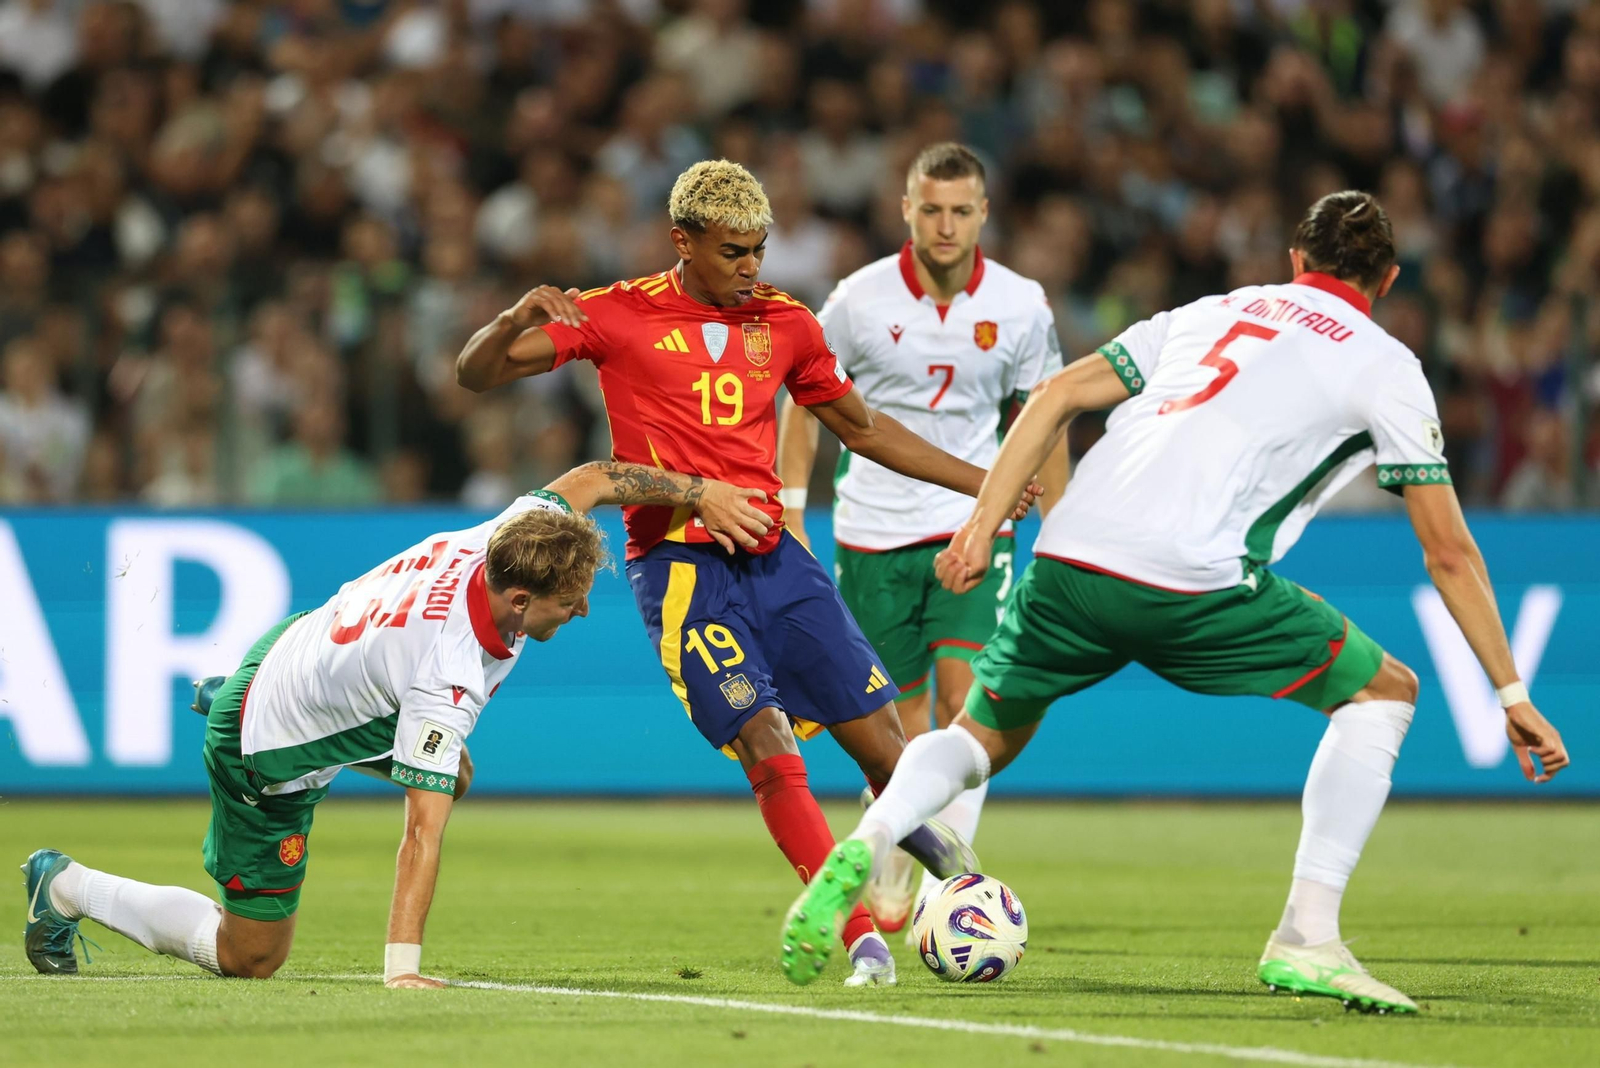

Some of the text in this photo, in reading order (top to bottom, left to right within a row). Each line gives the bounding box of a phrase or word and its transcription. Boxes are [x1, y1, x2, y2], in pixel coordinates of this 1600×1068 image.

[928, 365, 955, 409] 7
[1157, 320, 1280, 416] 5
[691, 371, 744, 426] 19
[993, 552, 1012, 601] 7
[684, 623, 745, 675] 19
